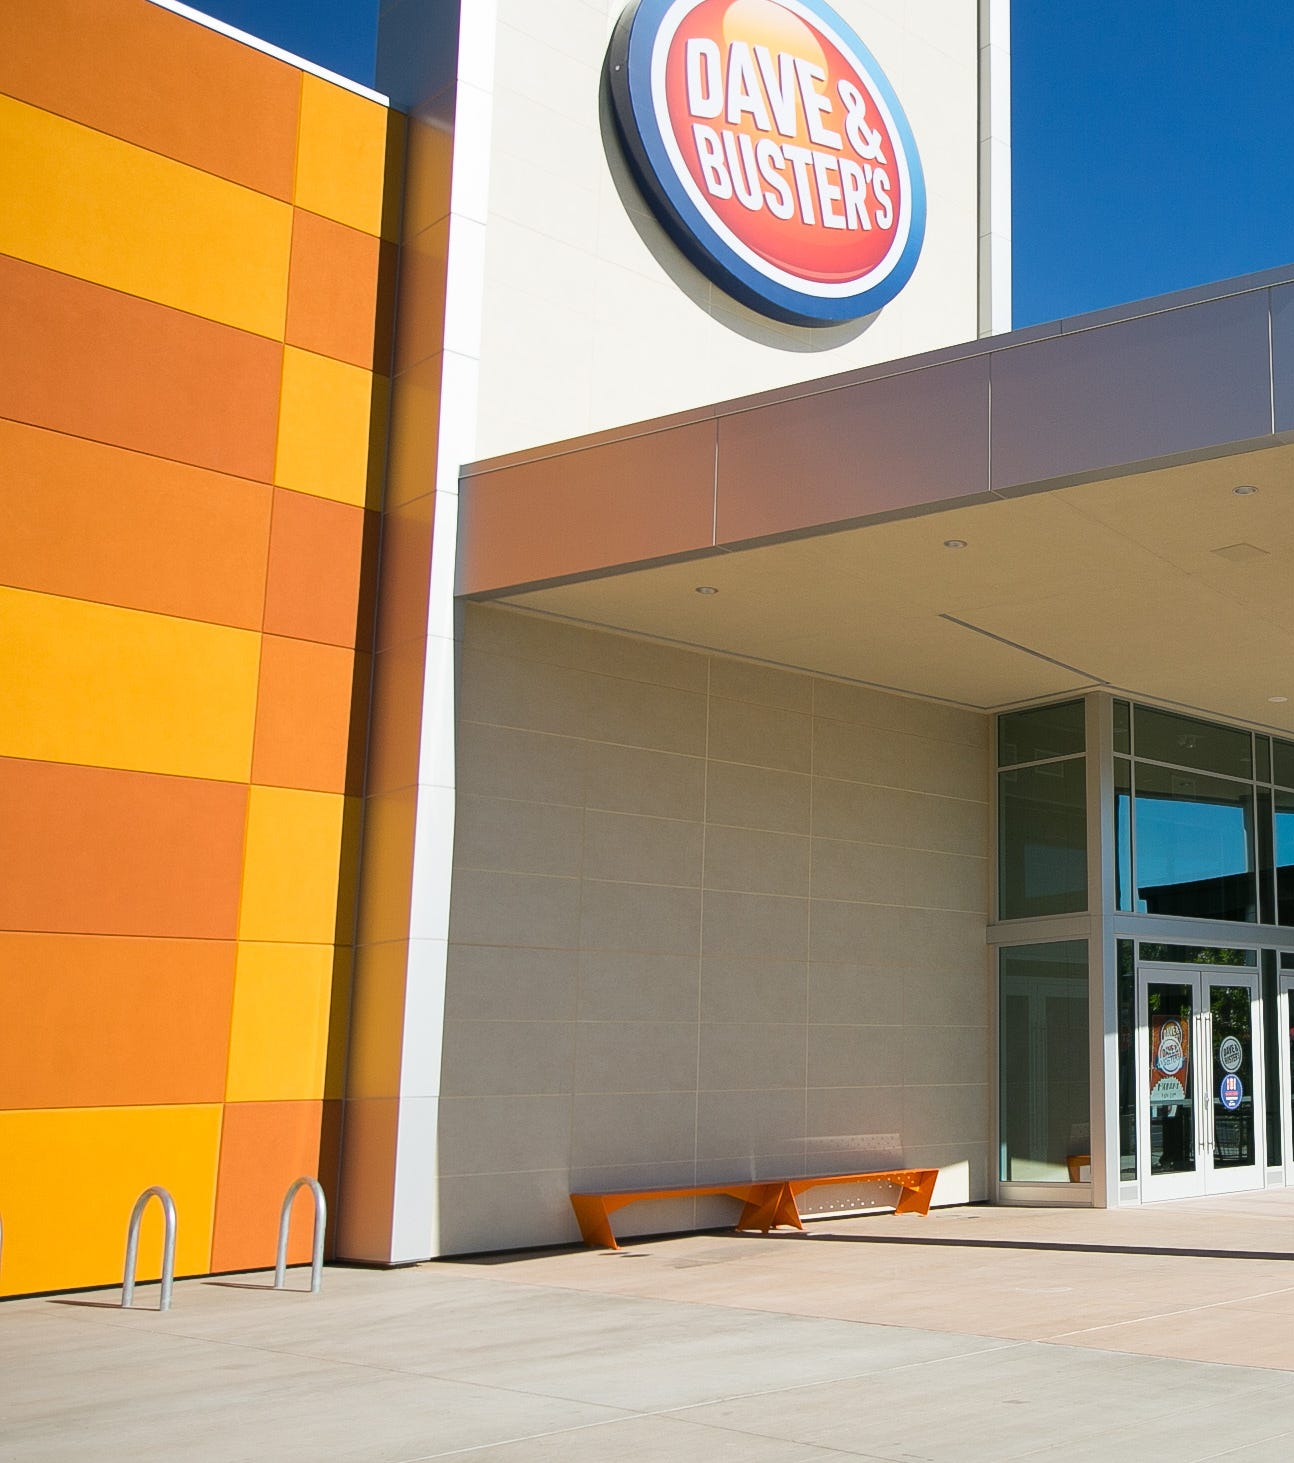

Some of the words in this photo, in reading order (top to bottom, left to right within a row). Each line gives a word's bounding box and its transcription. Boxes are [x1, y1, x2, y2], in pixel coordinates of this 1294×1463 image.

[684, 37, 843, 151] DAVE
[837, 78, 888, 165] &
[691, 122, 894, 232] BUSTER'S
